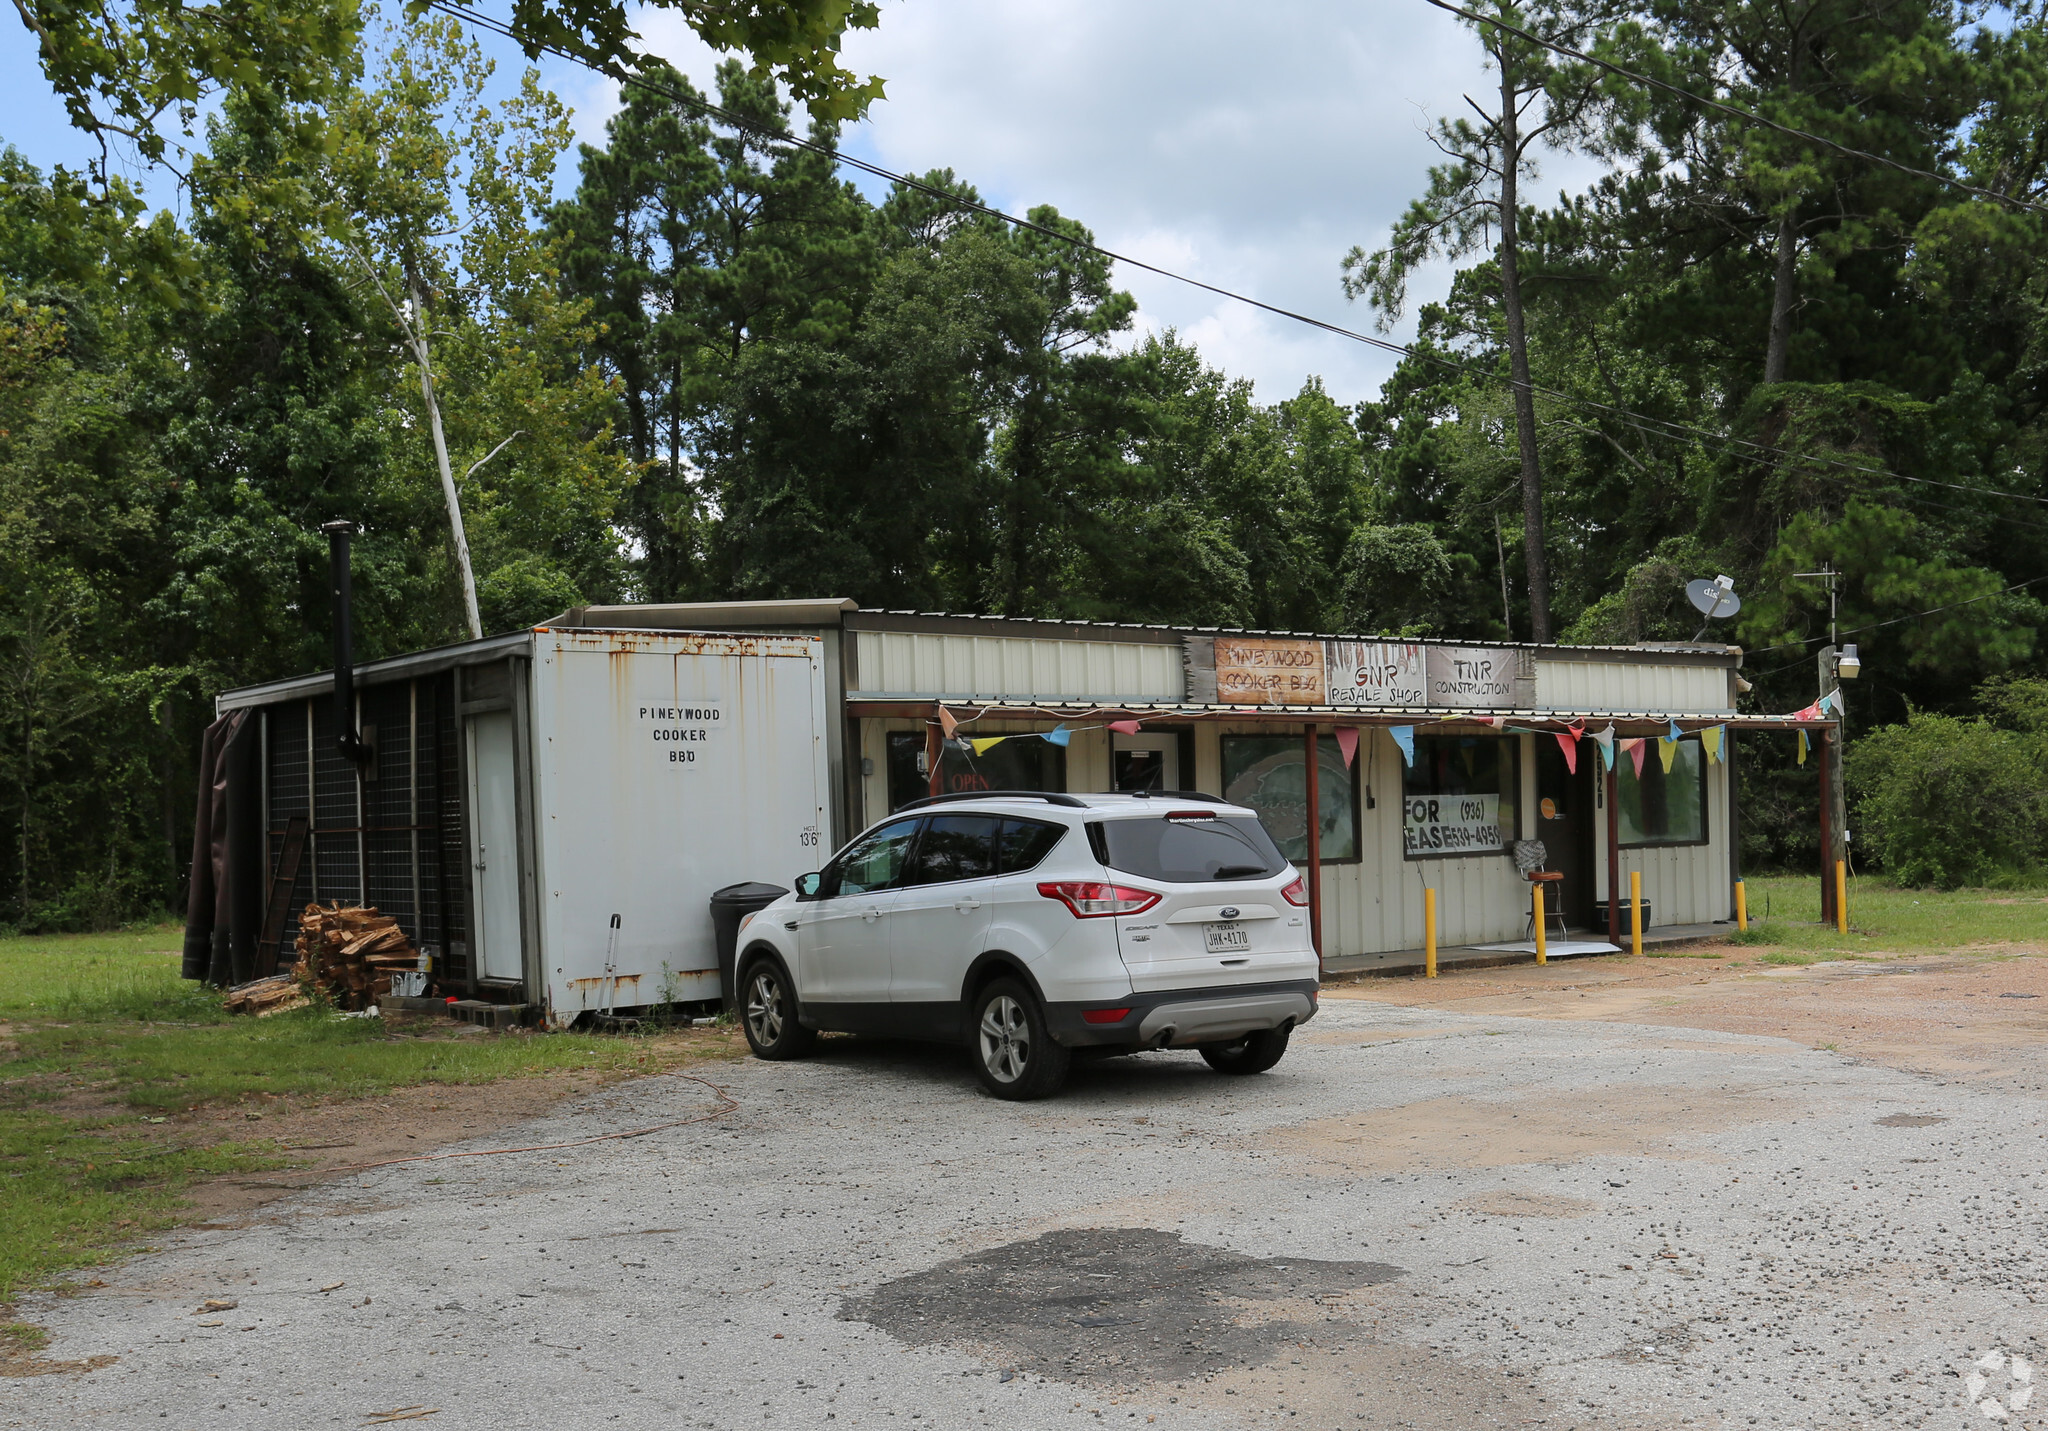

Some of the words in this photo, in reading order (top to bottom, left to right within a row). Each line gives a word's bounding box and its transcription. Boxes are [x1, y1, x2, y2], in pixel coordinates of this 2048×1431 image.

[1227, 648, 1314, 667] PINEYWOOD
[1355, 663, 1399, 688] GNR
[1454, 659, 1493, 681] TNR
[1225, 673, 1282, 690] COOKER
[1290, 674, 1317, 692] BBQ
[1434, 680, 1511, 696] CONSTRUCTION
[1331, 687, 1381, 702] RESALE
[1389, 687, 1423, 703] SHOP
[639, 707, 720, 721] PINEYWOOD
[653, 729, 707, 742] COOKER
[951, 773, 990, 792] OPEN
[1406, 799, 1440, 823] FOR
[1460, 799, 1484, 823] (936)
[1406, 825, 1453, 850] EASE
